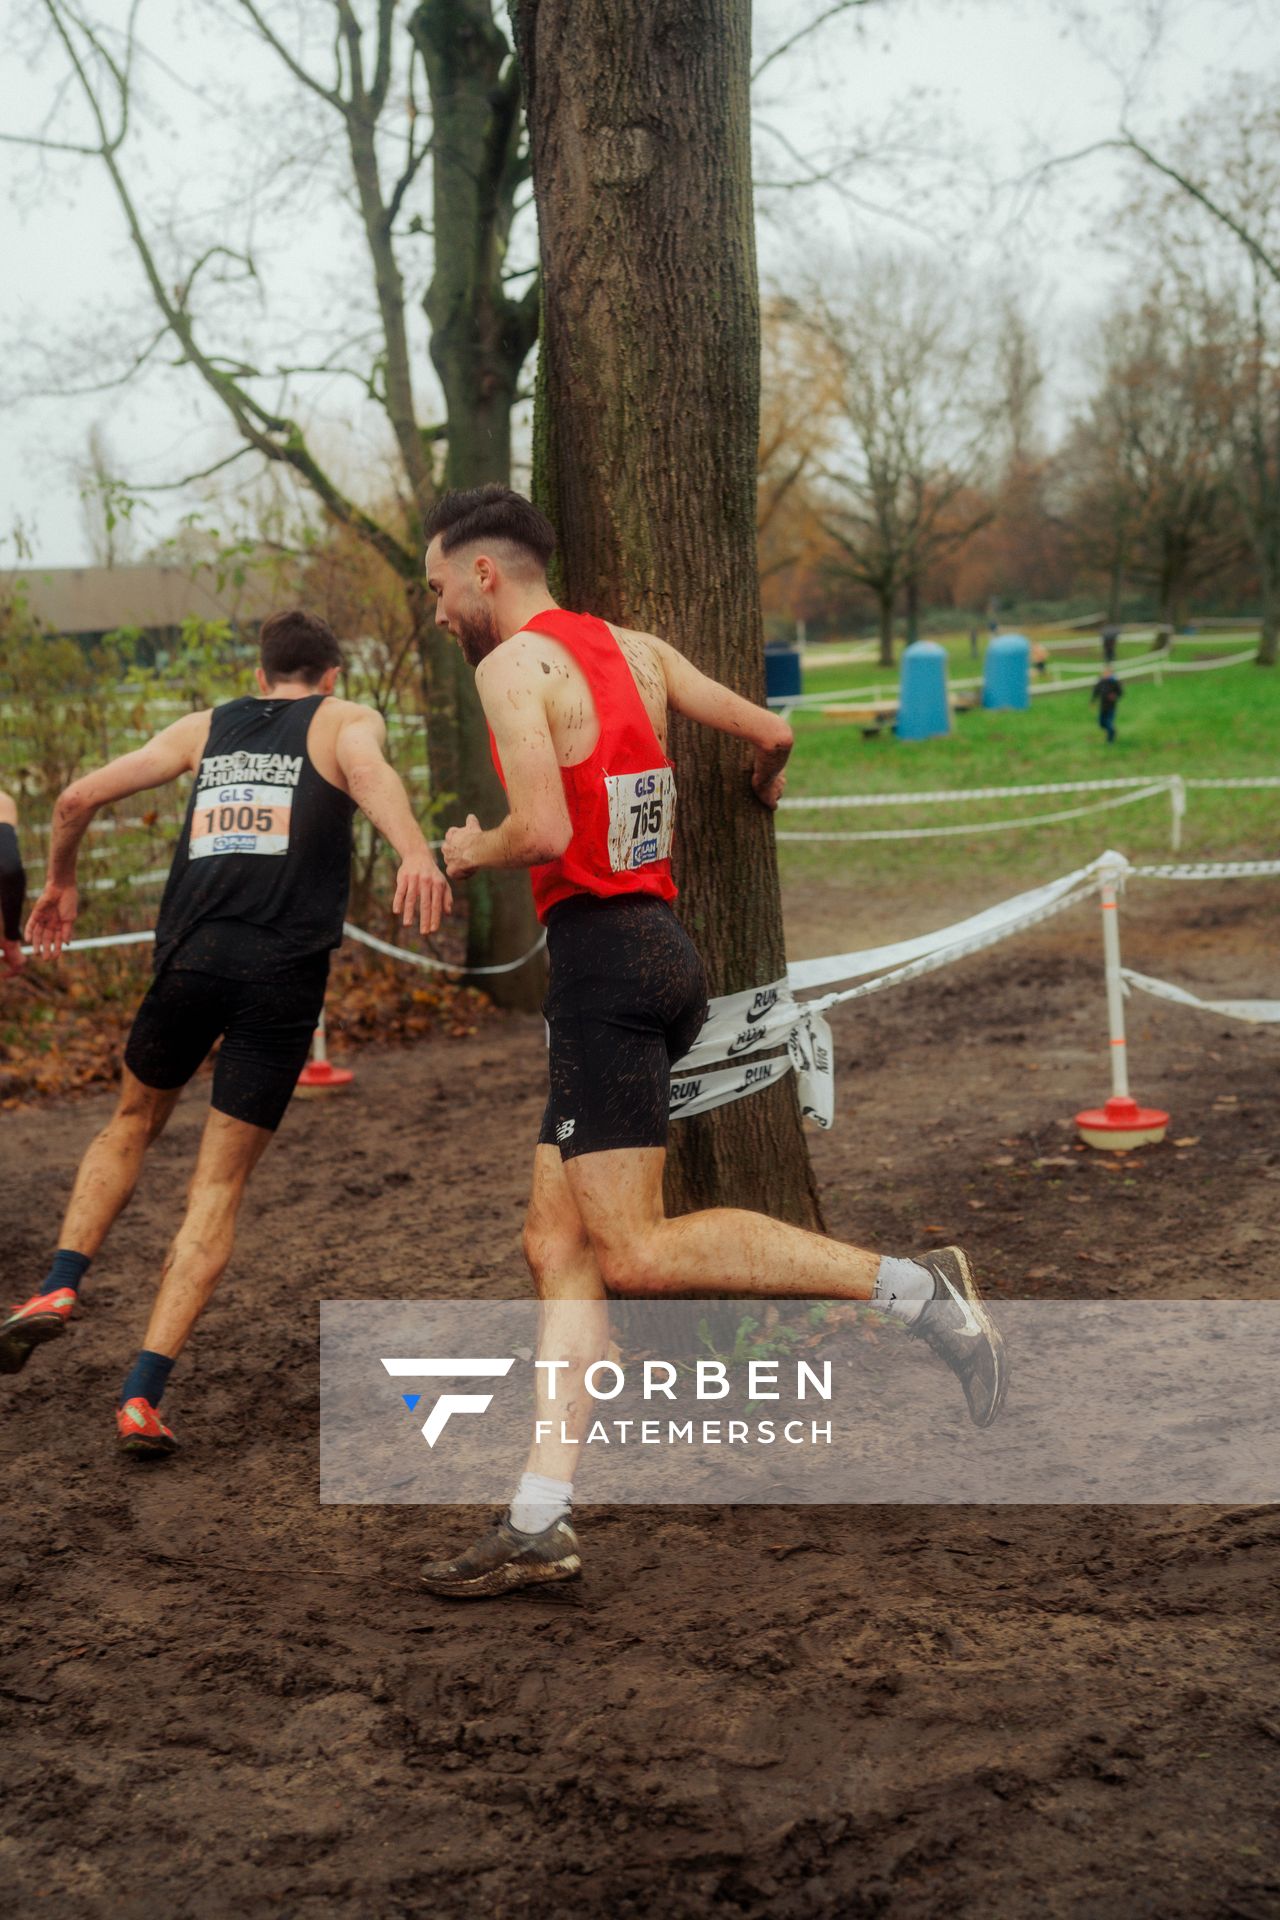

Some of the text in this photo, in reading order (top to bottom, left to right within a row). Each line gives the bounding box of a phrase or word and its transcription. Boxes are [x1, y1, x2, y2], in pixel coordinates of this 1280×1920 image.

[247, 753, 304, 772] TEAM
[219, 788, 255, 803] GLS
[635, 775, 656, 798] GLS
[204, 806, 274, 834] 1005
[630, 800, 663, 840] 765
[754, 988, 778, 1009] RUN
[745, 1065, 773, 1084] RUN
[670, 1081, 702, 1100] RUN
